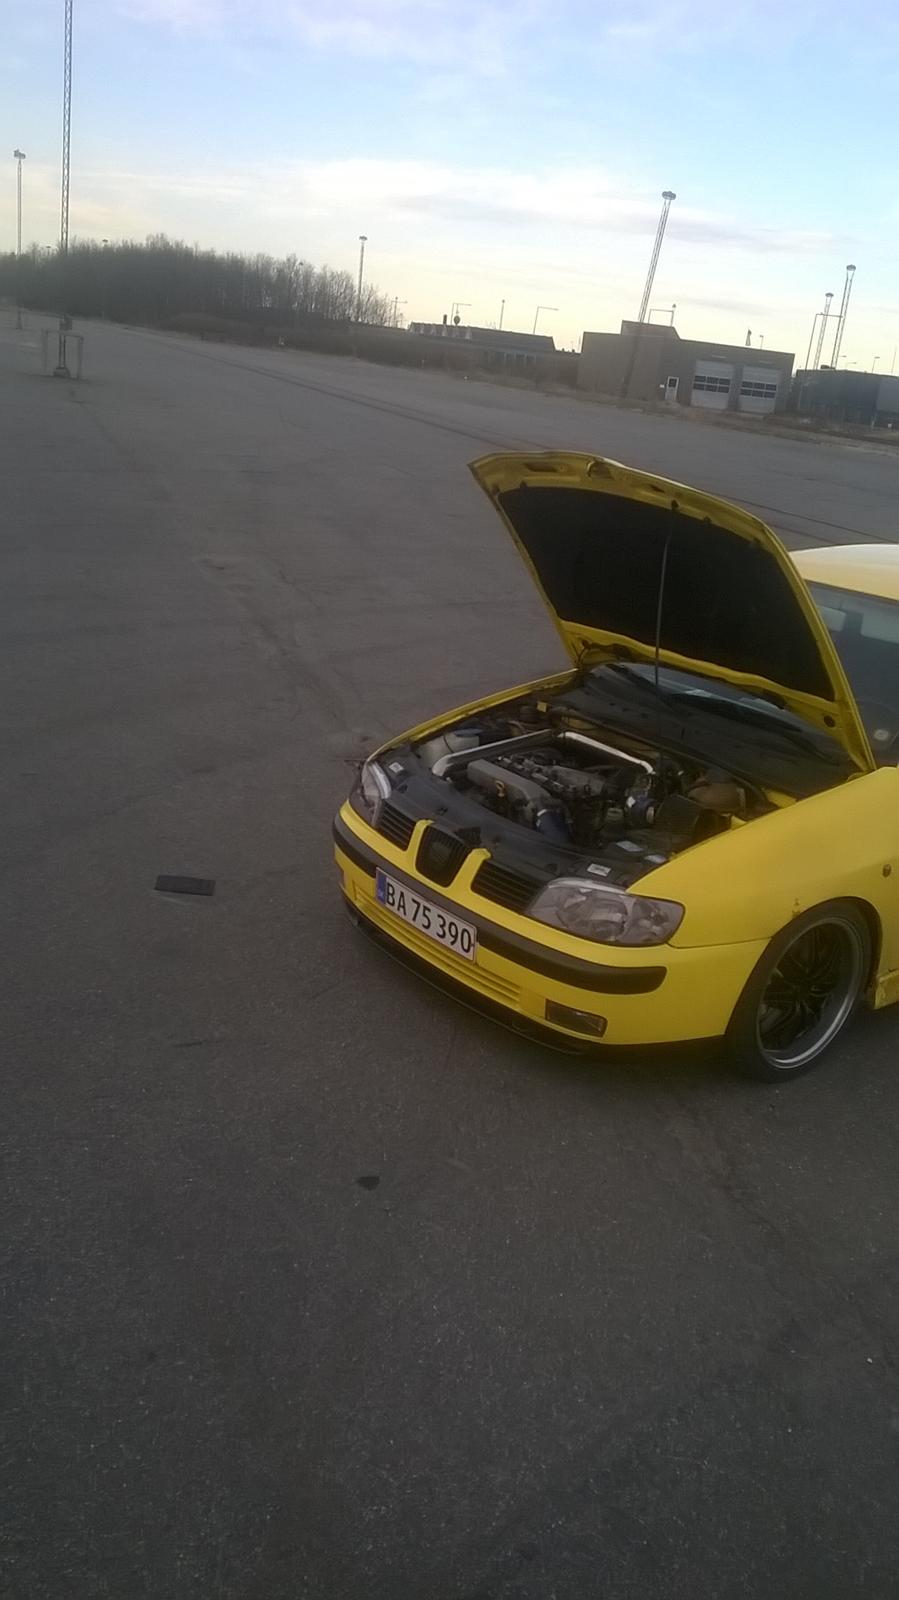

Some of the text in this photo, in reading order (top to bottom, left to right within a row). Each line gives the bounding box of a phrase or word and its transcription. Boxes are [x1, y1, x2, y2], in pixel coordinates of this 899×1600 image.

[386, 883, 407, 916] BA
[411, 898, 431, 930] 75
[436, 914, 472, 954] 390
